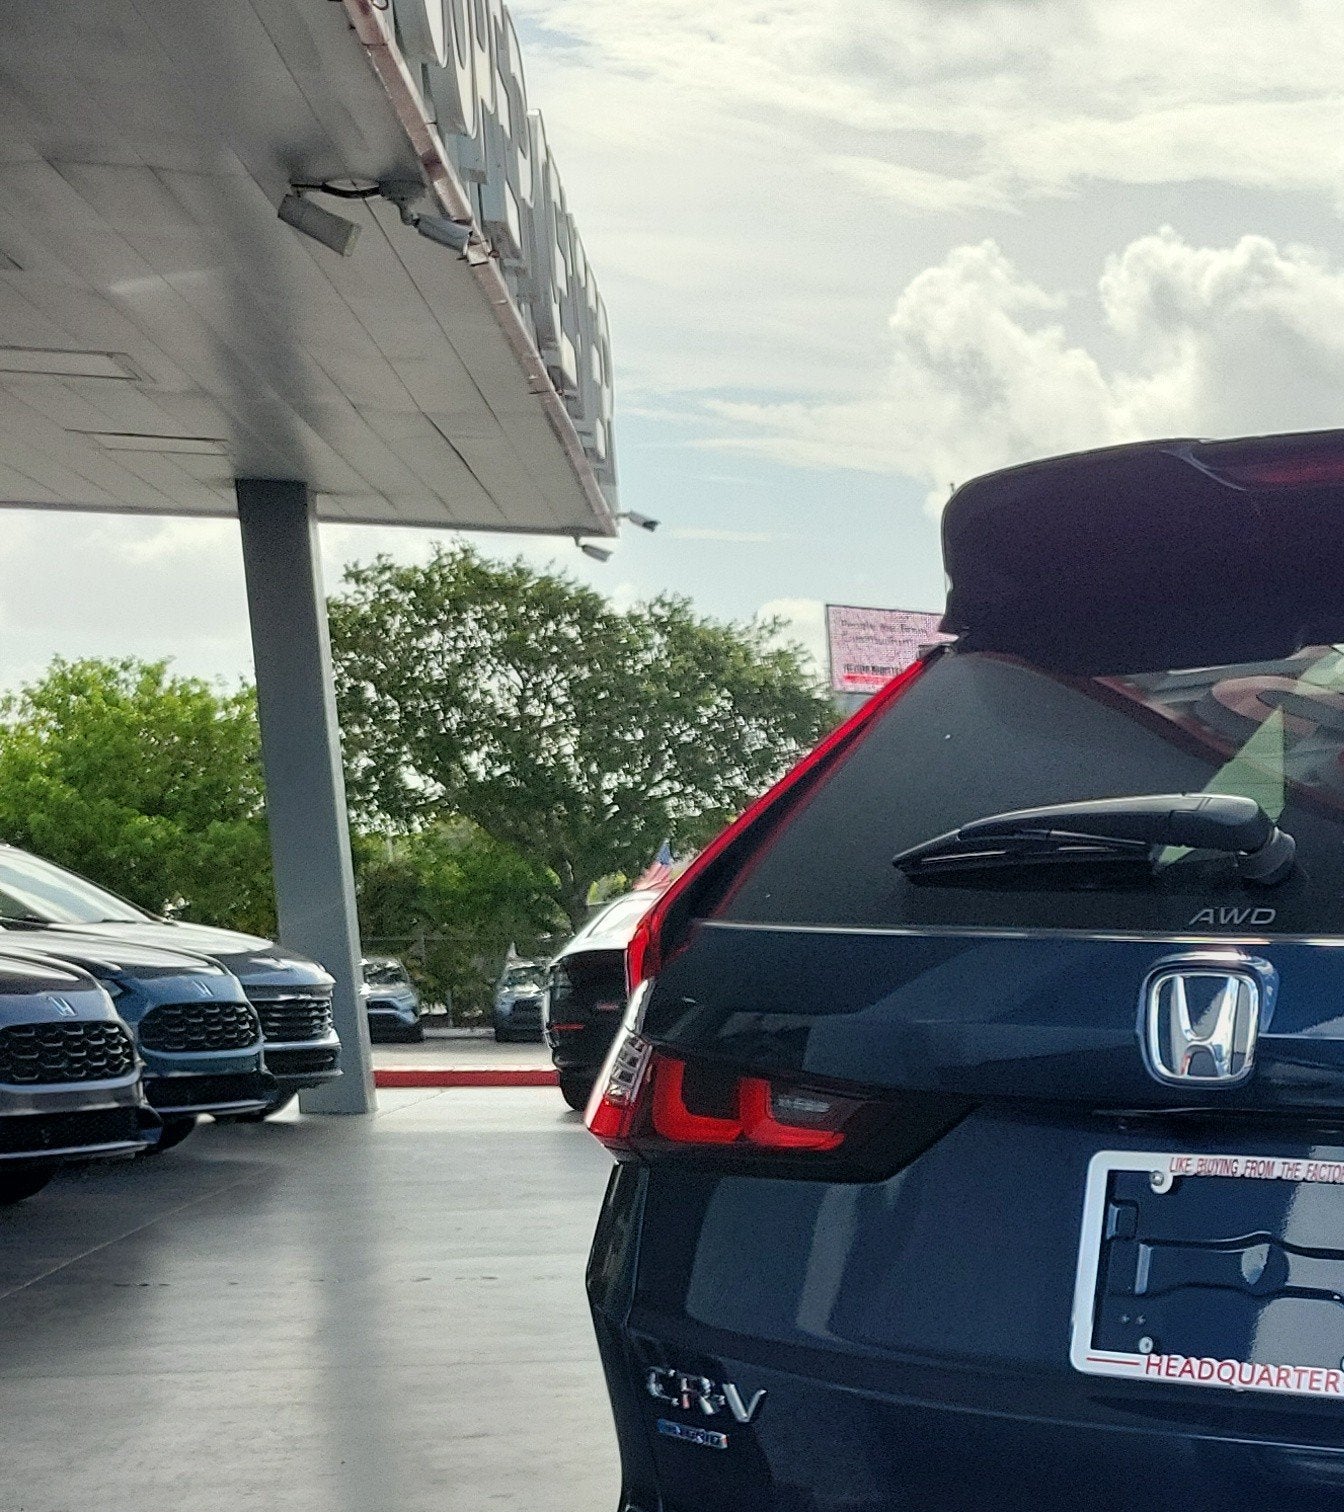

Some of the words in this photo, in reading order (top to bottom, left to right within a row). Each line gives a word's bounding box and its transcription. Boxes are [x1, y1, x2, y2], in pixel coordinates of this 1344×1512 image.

[1188, 908, 1276, 925] AWD
[1169, 1157, 1191, 1173] LIKE
[1196, 1158, 1239, 1176] BUYING
[1244, 1160, 1275, 1178] FROM
[1281, 1161, 1301, 1179] THE
[1144, 1354, 1341, 1394] HEADQUARTER
[646, 1366, 768, 1422] CR-V
